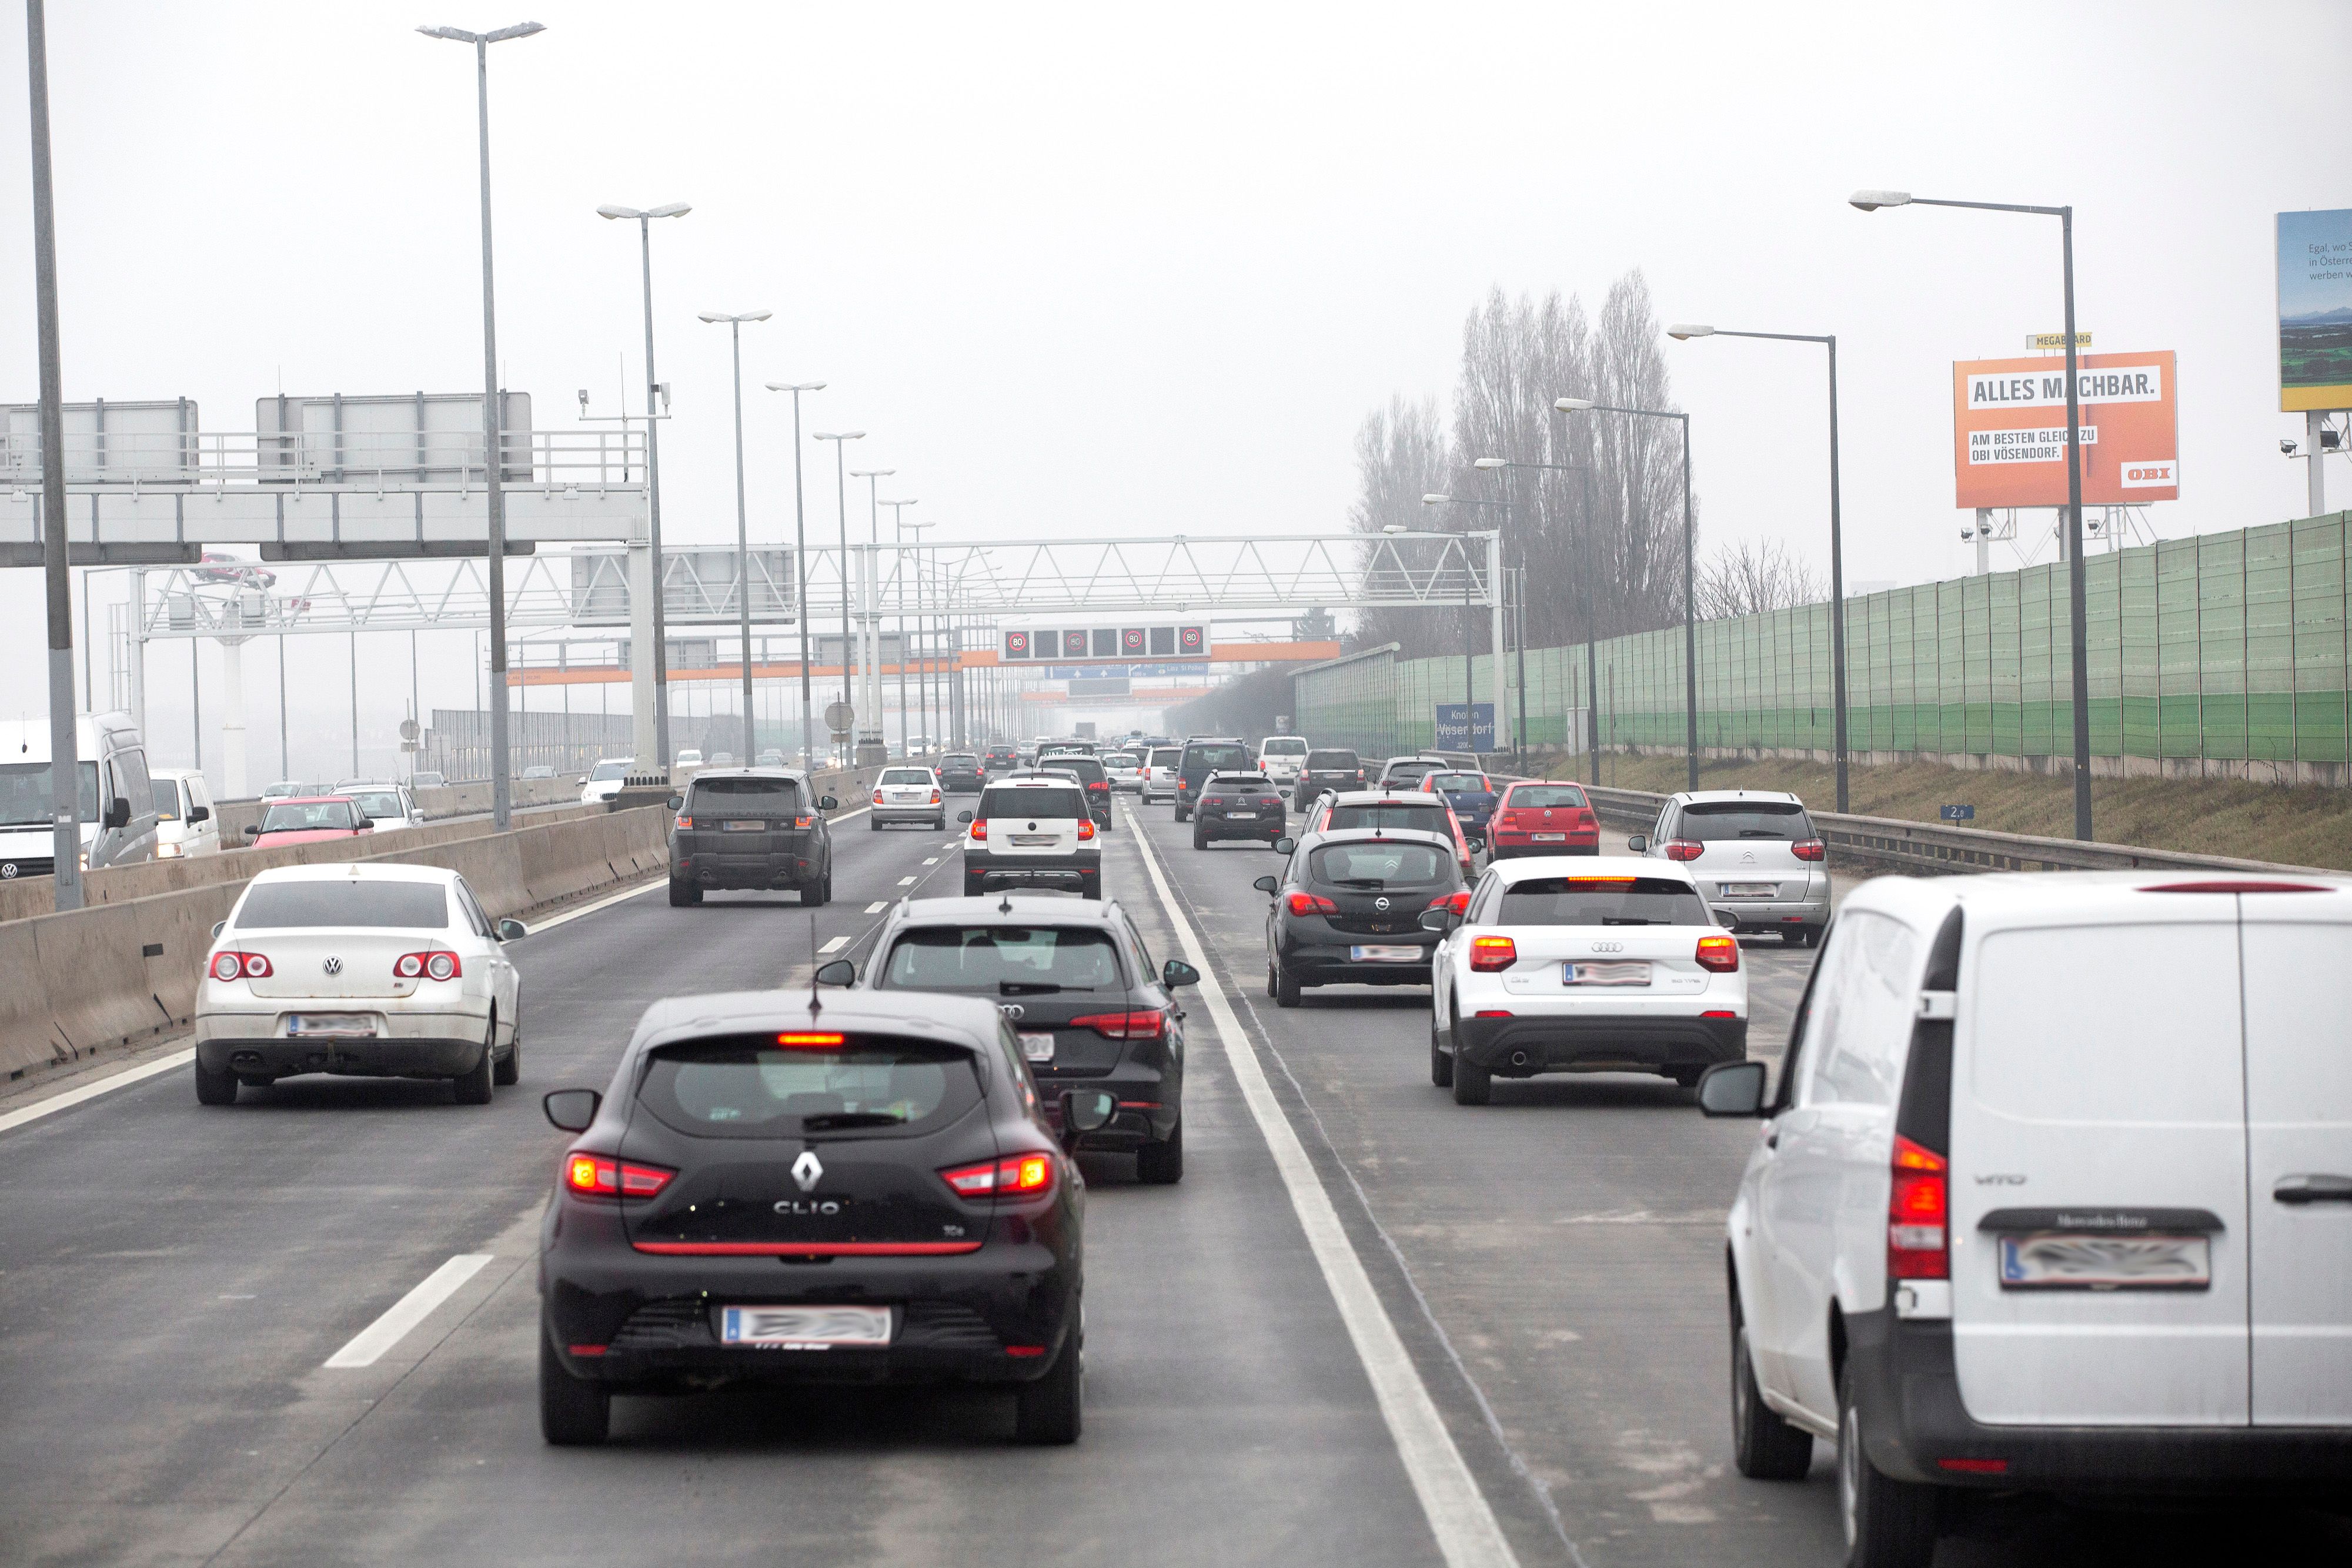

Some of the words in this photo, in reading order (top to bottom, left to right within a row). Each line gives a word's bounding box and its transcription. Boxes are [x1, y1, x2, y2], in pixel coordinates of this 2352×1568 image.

[2309, 243, 2330, 255] Egal,
[2309, 258, 2317, 266] in
[2310, 270, 2343, 280] werben
[2036, 335, 2092, 346] MEGABARD
[1973, 379, 2035, 402] ALLES
[2043, 373, 2155, 399] MCHBAR.
[1972, 434, 1990, 446] AM
[1994, 432, 2035, 444] BESTEN
[2039, 430, 2068, 443] GLEIC
[2080, 430, 2095, 441] ZU
[1972, 449, 1990, 462] OBI
[1994, 446, 2060, 460] VÖSENDORF.
[2127, 467, 2170, 481] OBI
[1013, 638, 1023, 646] 80
[1451, 710, 1479, 720] Knon
[773, 1200, 840, 1215] CLIO
